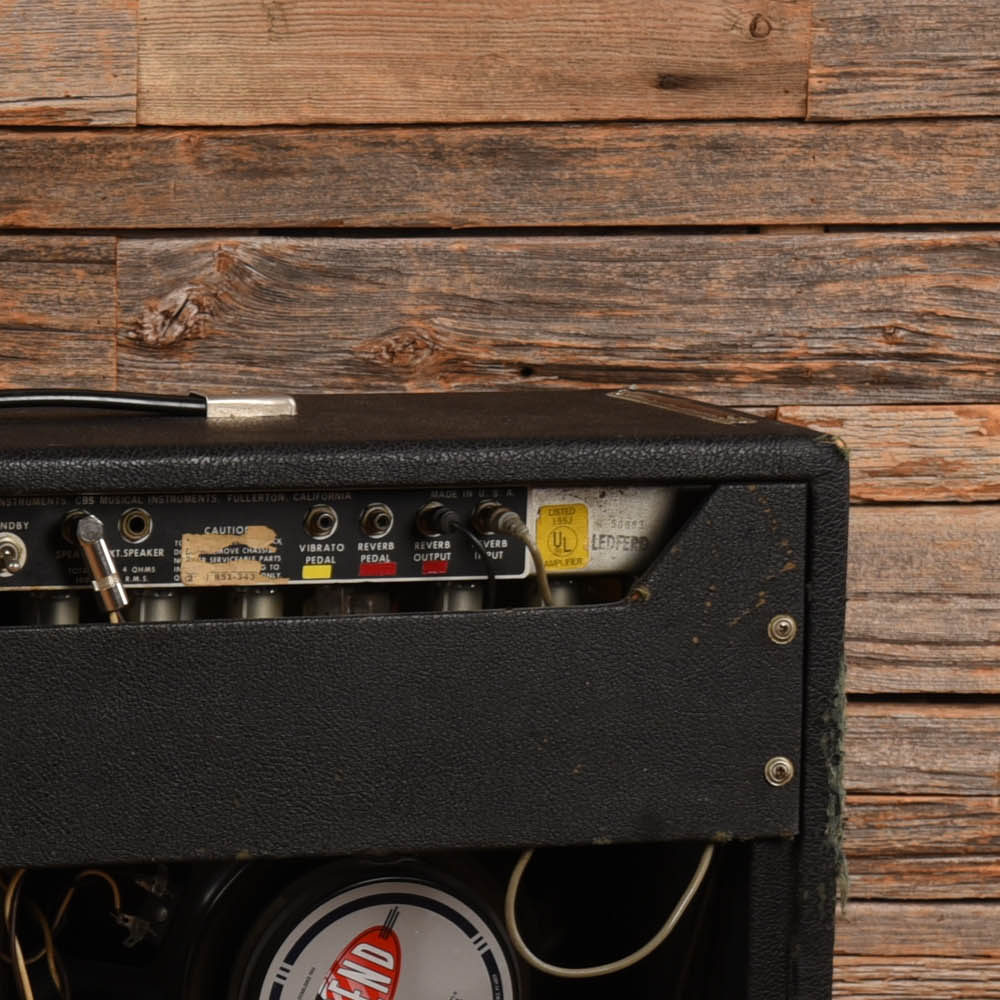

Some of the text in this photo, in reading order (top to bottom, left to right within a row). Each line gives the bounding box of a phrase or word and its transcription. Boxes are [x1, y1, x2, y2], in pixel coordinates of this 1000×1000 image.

[292, 492, 352, 501] CALIFORNIA
[431, 488, 456, 497] MADE
[463, 488, 472, 496] IN
[75, 495, 217, 504] CBS MUSICAL INSTRUMENTS
[299, 543, 345, 553] VIBRATO
[358, 542, 395, 551] REVERB
[414, 540, 451, 550] REVERB
[481, 539, 508, 549] VERB
[110, 548, 165, 558] XT.SPEAKER
[413, 552, 452, 562] OUTPUT
[305, 555, 336, 564] PEDAL
[360, 554, 391, 563] PEDAL
[131, 566, 156, 574] OHMS
